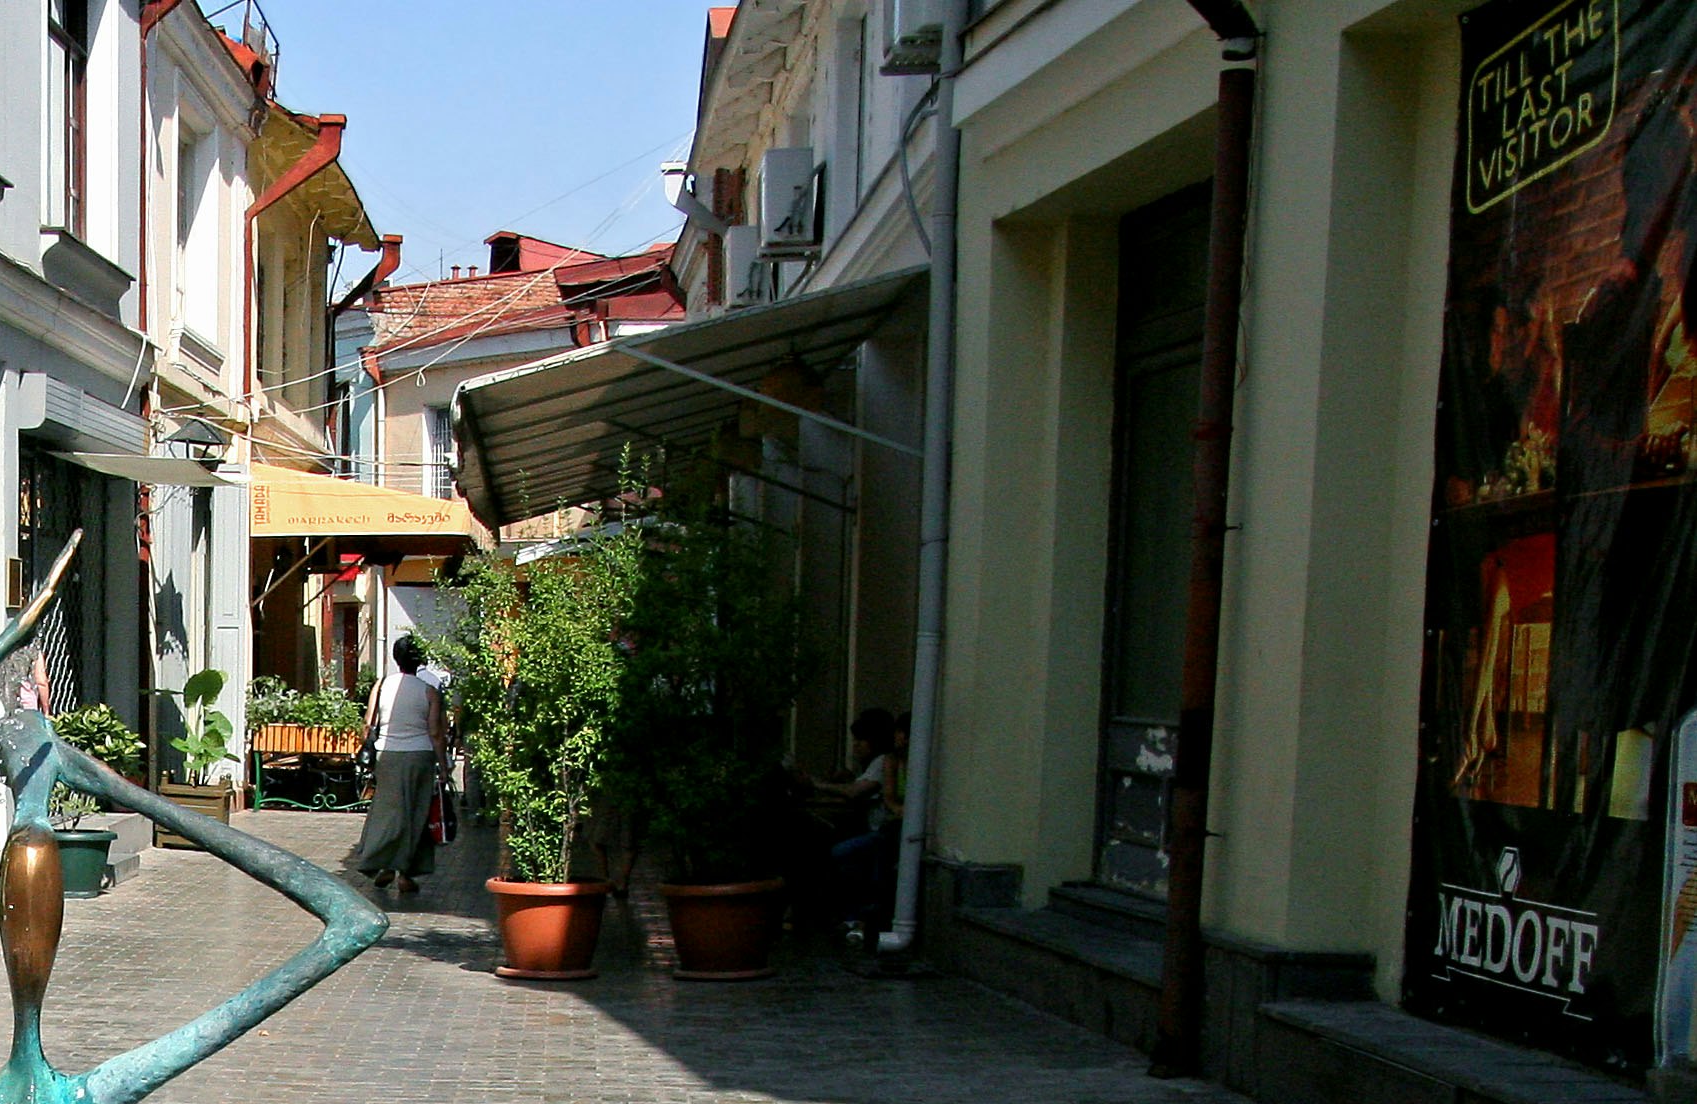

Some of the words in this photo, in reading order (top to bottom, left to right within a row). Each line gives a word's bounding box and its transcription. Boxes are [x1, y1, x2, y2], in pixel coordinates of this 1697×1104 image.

[1477, 51, 1533, 112] TILL
[1543, 0, 1602, 66] THE
[1502, 59, 1575, 139] LAST
[1479, 92, 1593, 190] VISITOR
[253, 485, 266, 526] TAMADA
[1433, 892, 1599, 994] MEDOFF
